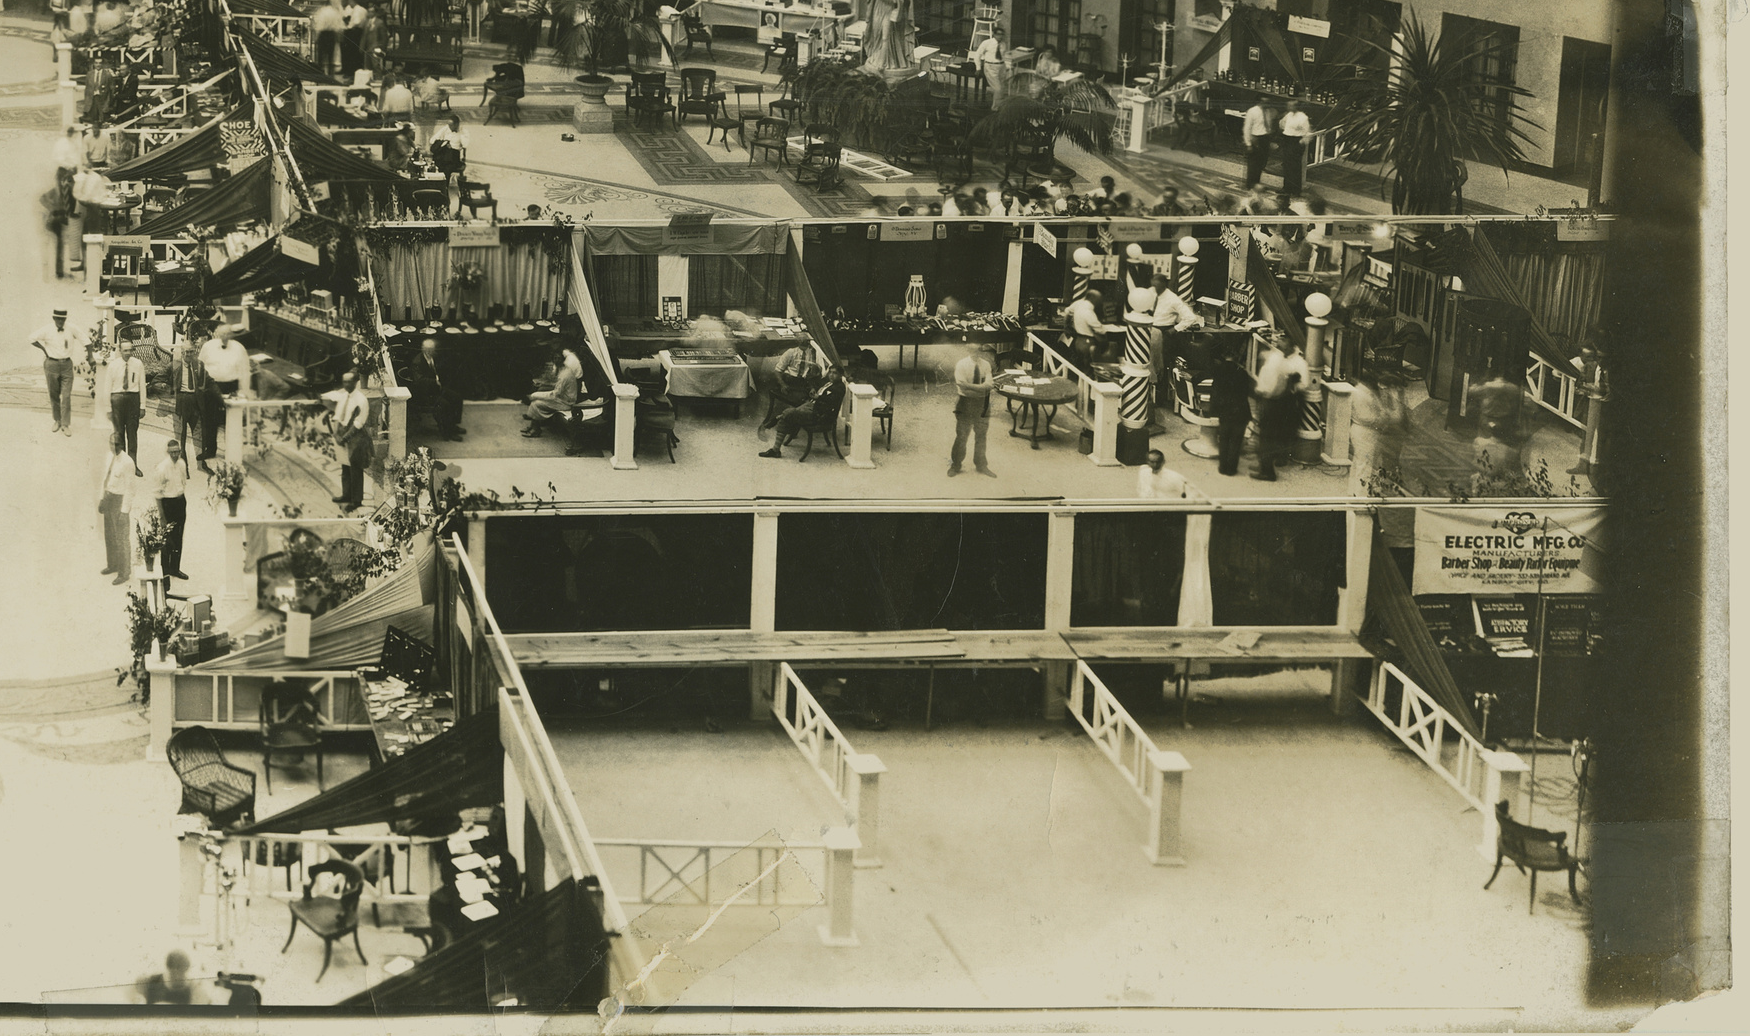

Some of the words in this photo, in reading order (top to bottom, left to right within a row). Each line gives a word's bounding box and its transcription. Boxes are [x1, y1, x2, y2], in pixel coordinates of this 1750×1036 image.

[219, 120, 251, 133] SHOE
[1445, 535, 1525, 549] ELECTRIC
[1533, 536, 1566, 550] MFG.
[1441, 556, 1470, 570] Barber
[1471, 557, 1492, 572] Shop
[1499, 557, 1526, 572] Beauty
